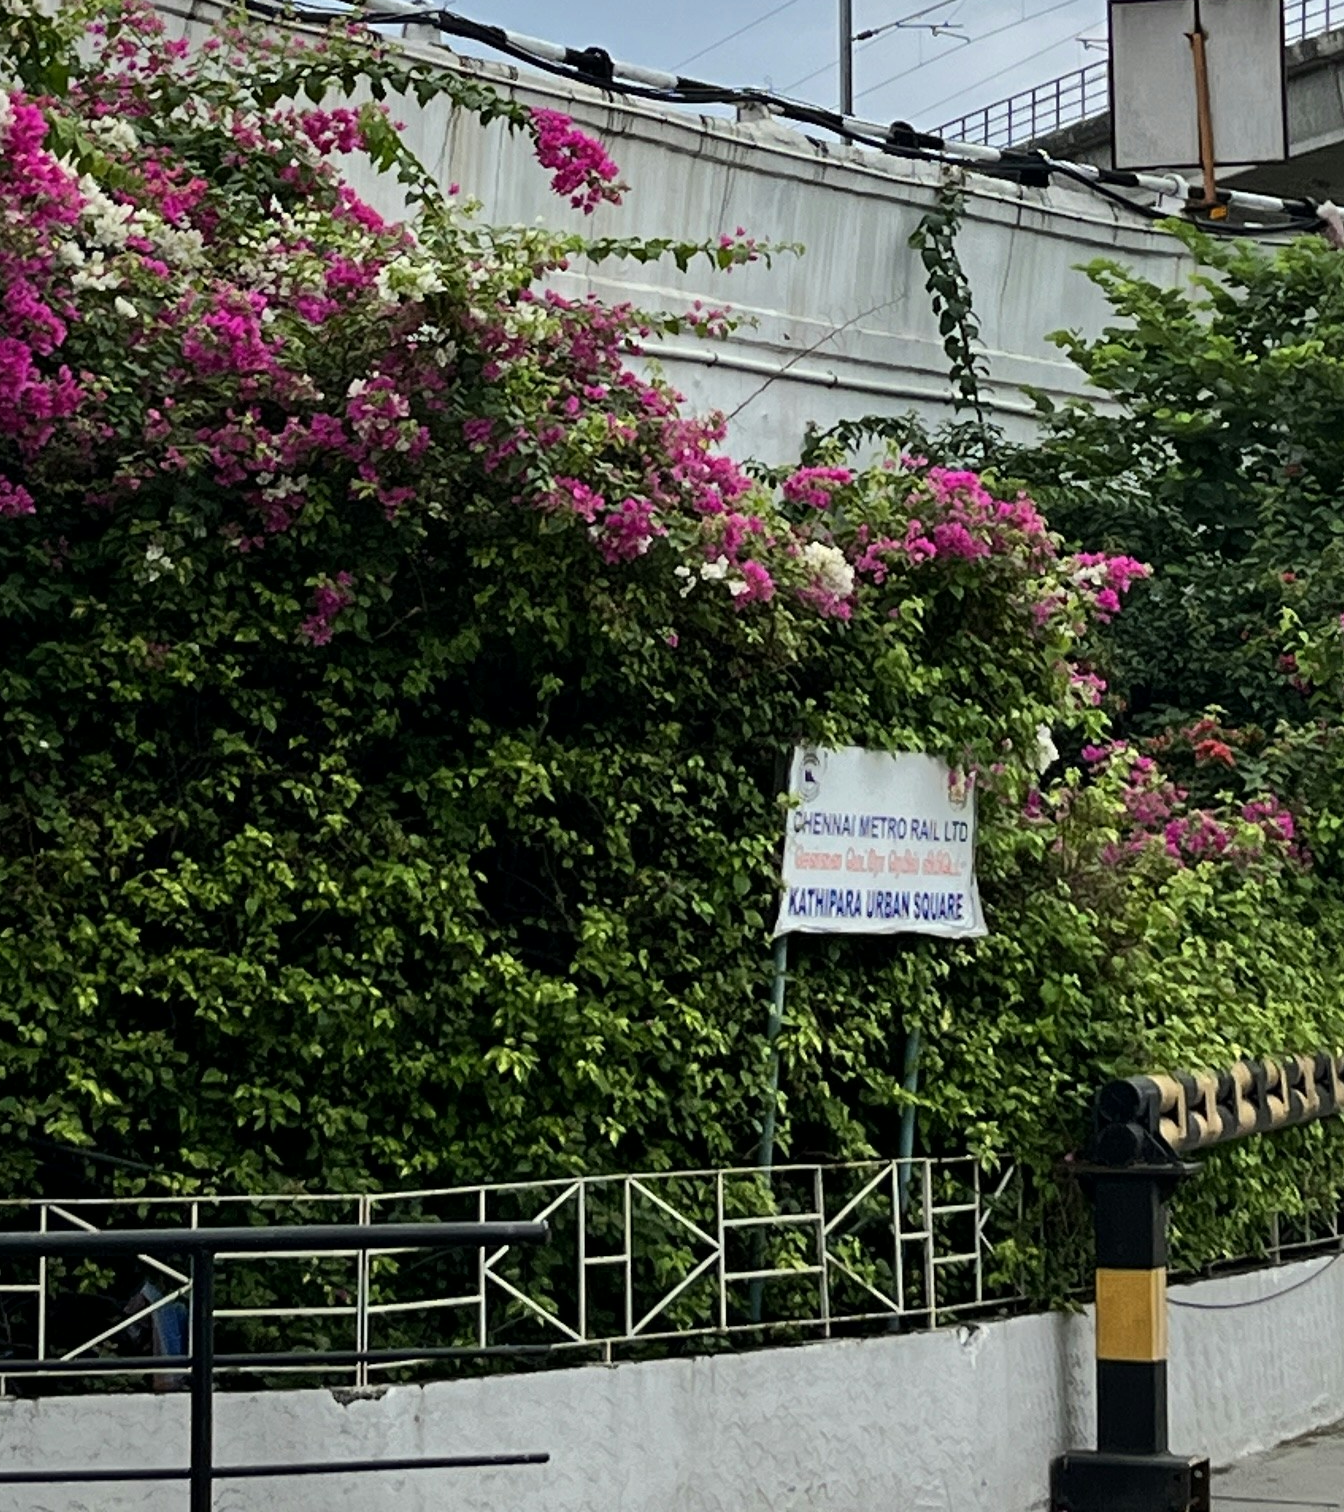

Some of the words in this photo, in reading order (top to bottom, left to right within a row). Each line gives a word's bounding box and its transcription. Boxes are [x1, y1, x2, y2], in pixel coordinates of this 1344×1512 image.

[794, 811, 856, 837] CHENNAI
[859, 815, 907, 840] METRO
[910, 818, 940, 842] RAIL
[944, 821, 968, 842] LTD
[788, 888, 862, 918] KATHIPARA
[866, 890, 910, 919] URBAN
[913, 892, 964, 921] SQUARE
